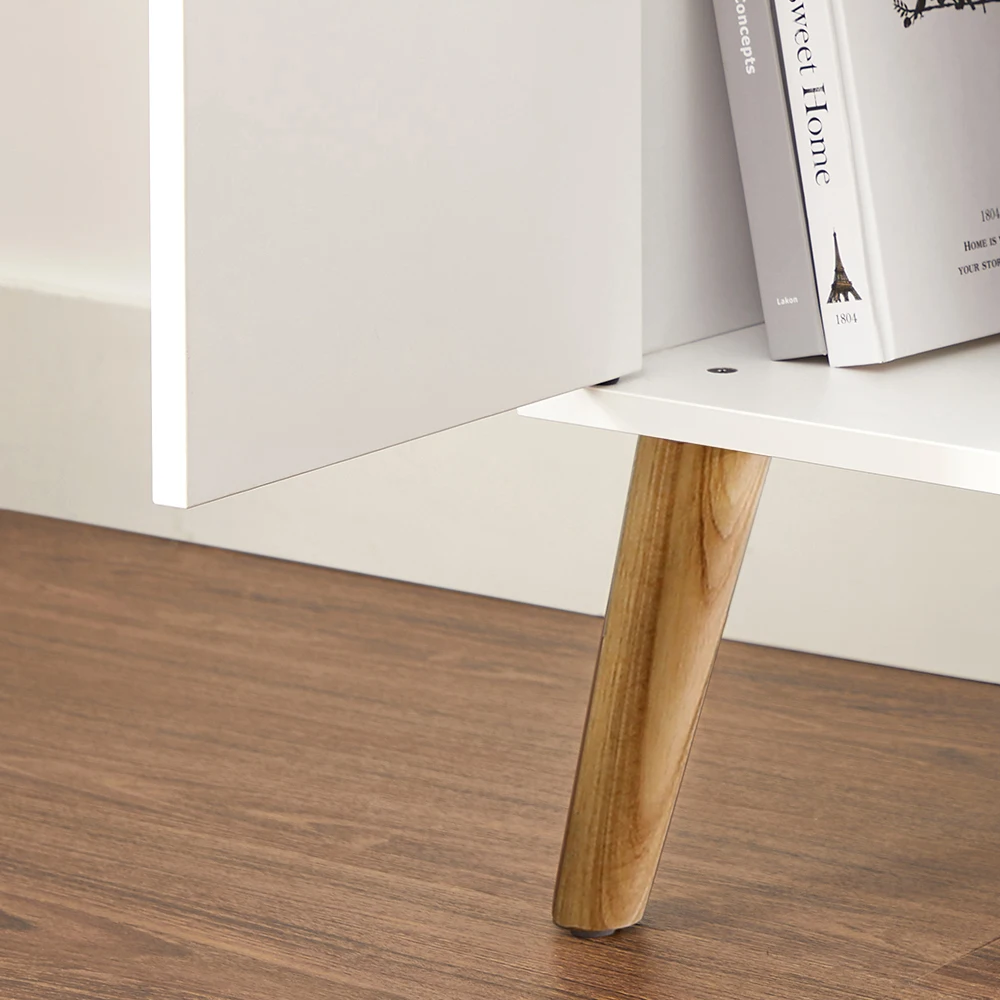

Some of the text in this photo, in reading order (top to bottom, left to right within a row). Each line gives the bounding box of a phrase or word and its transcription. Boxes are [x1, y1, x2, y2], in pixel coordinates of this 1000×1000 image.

[801, 84, 830, 186] Home
[981, 207, 1000, 222] 1804
[958, 262, 980, 275] YOUR
[776, 296, 798, 306] Lakon
[835, 312, 858, 325] 1804
